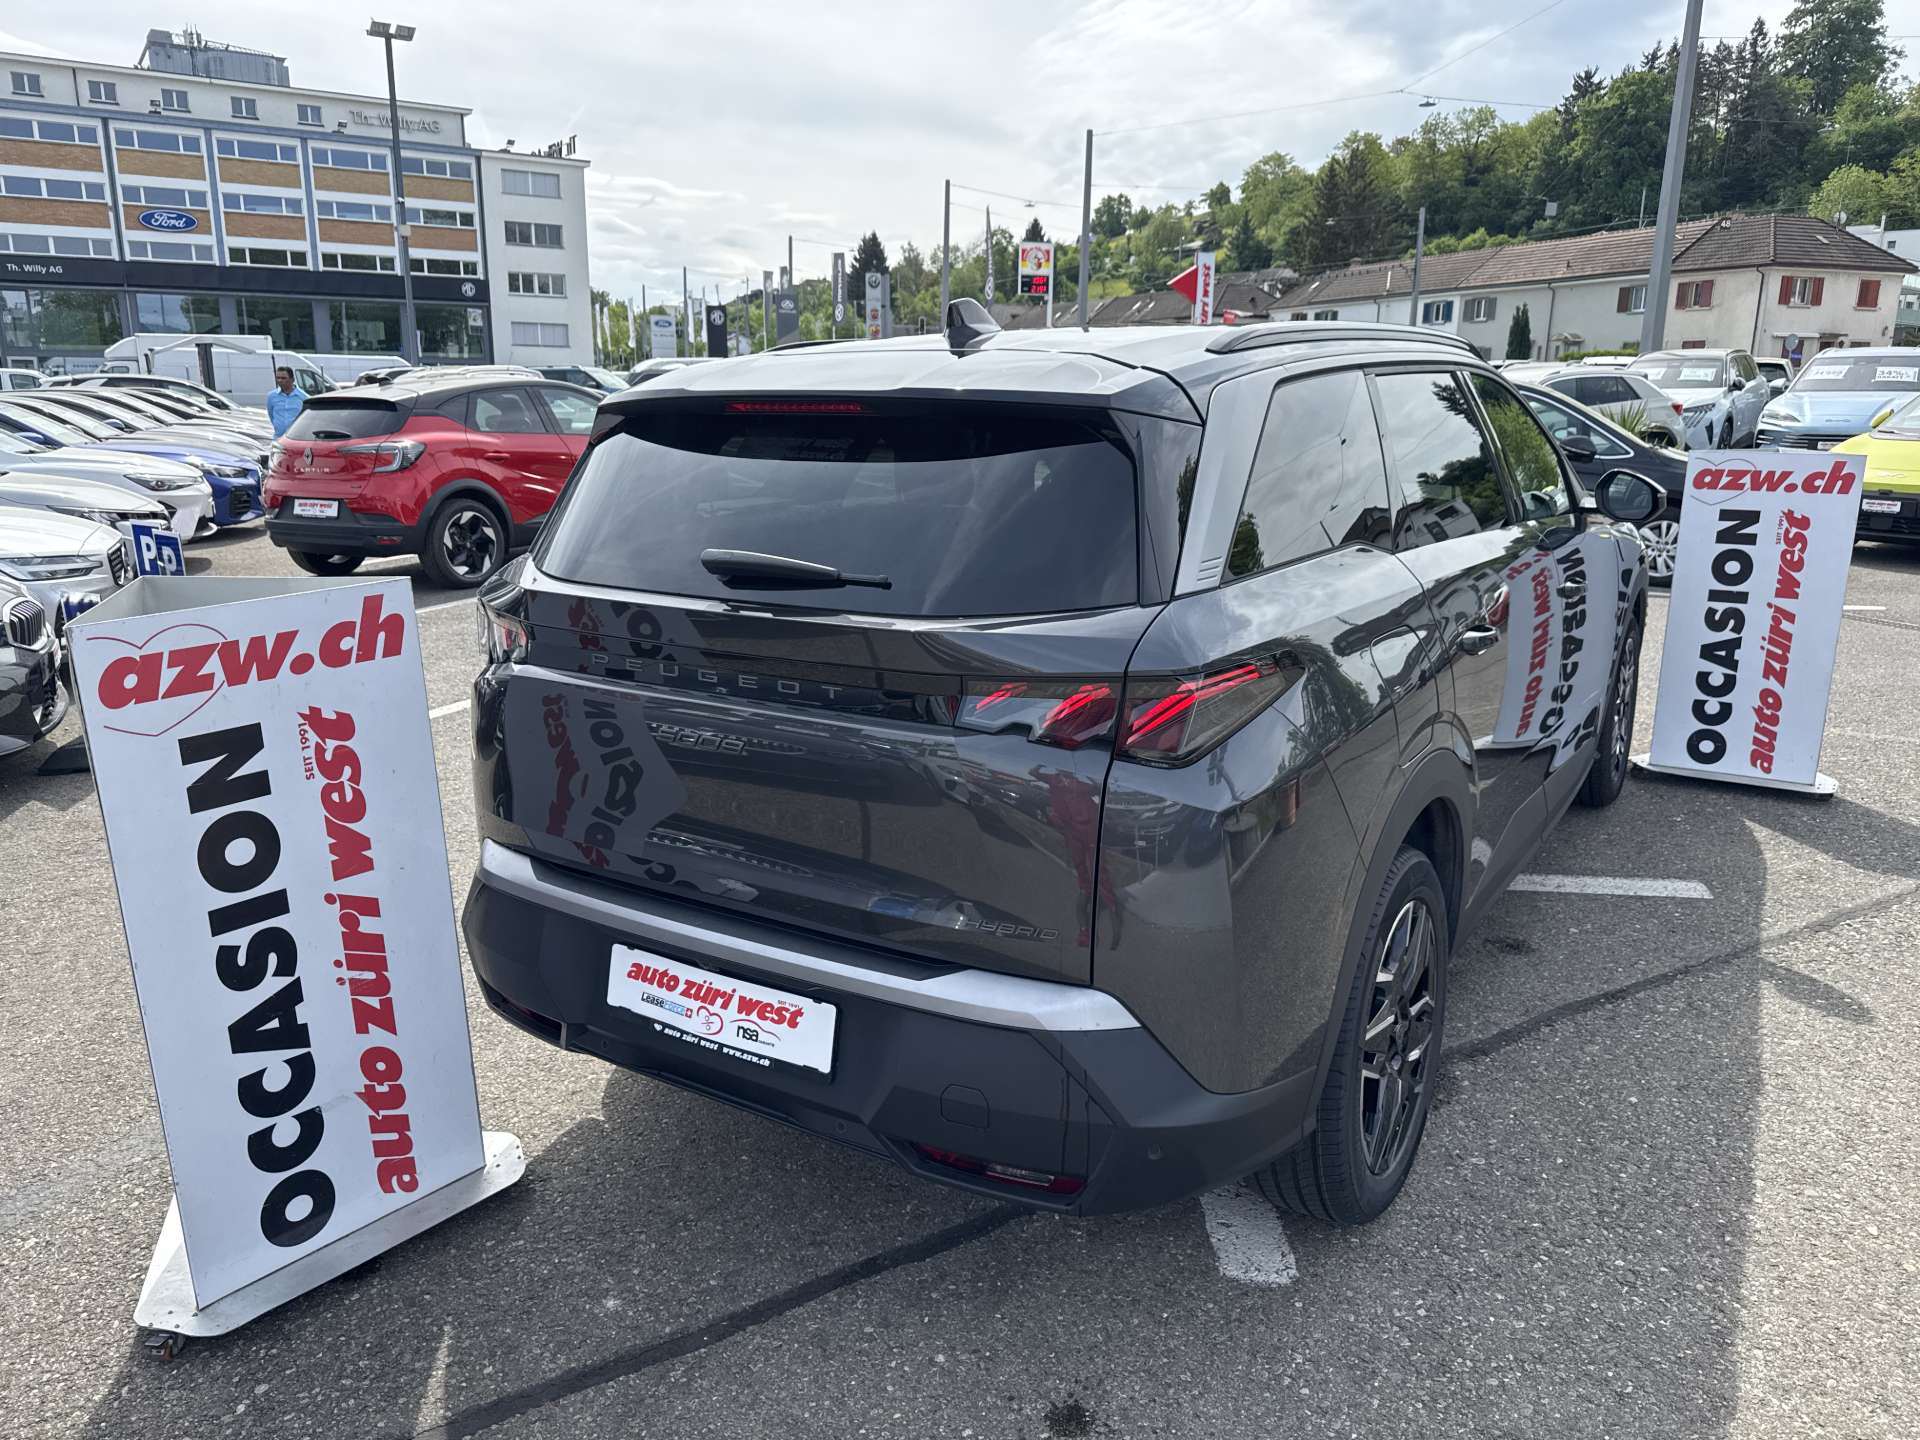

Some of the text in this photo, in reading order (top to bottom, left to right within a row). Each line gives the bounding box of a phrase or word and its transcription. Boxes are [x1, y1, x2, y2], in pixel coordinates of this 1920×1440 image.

[379, 112, 417, 134] Wlly
[418, 121, 441, 134] AG
[150, 212, 187, 229] Ford
[6, 263, 63, 274] Th. Willy AG
[1692, 460, 1857, 495] azw.ch
[98, 593, 405, 709] azw.ch
[1686, 508, 1761, 765] OCCASION
[1750, 508, 1811, 774] auto züri west
[592, 653, 843, 699] PEUGEOT
[297, 720, 315, 781] SEIT 1991
[296, 705, 420, 1195] auto züri west
[178, 722, 336, 1248] OCCASION
[626, 962, 680, 992] auto
[679, 979, 736, 1010] züri
[737, 995, 805, 1029] west
[736, 1024, 759, 1043] nsa
